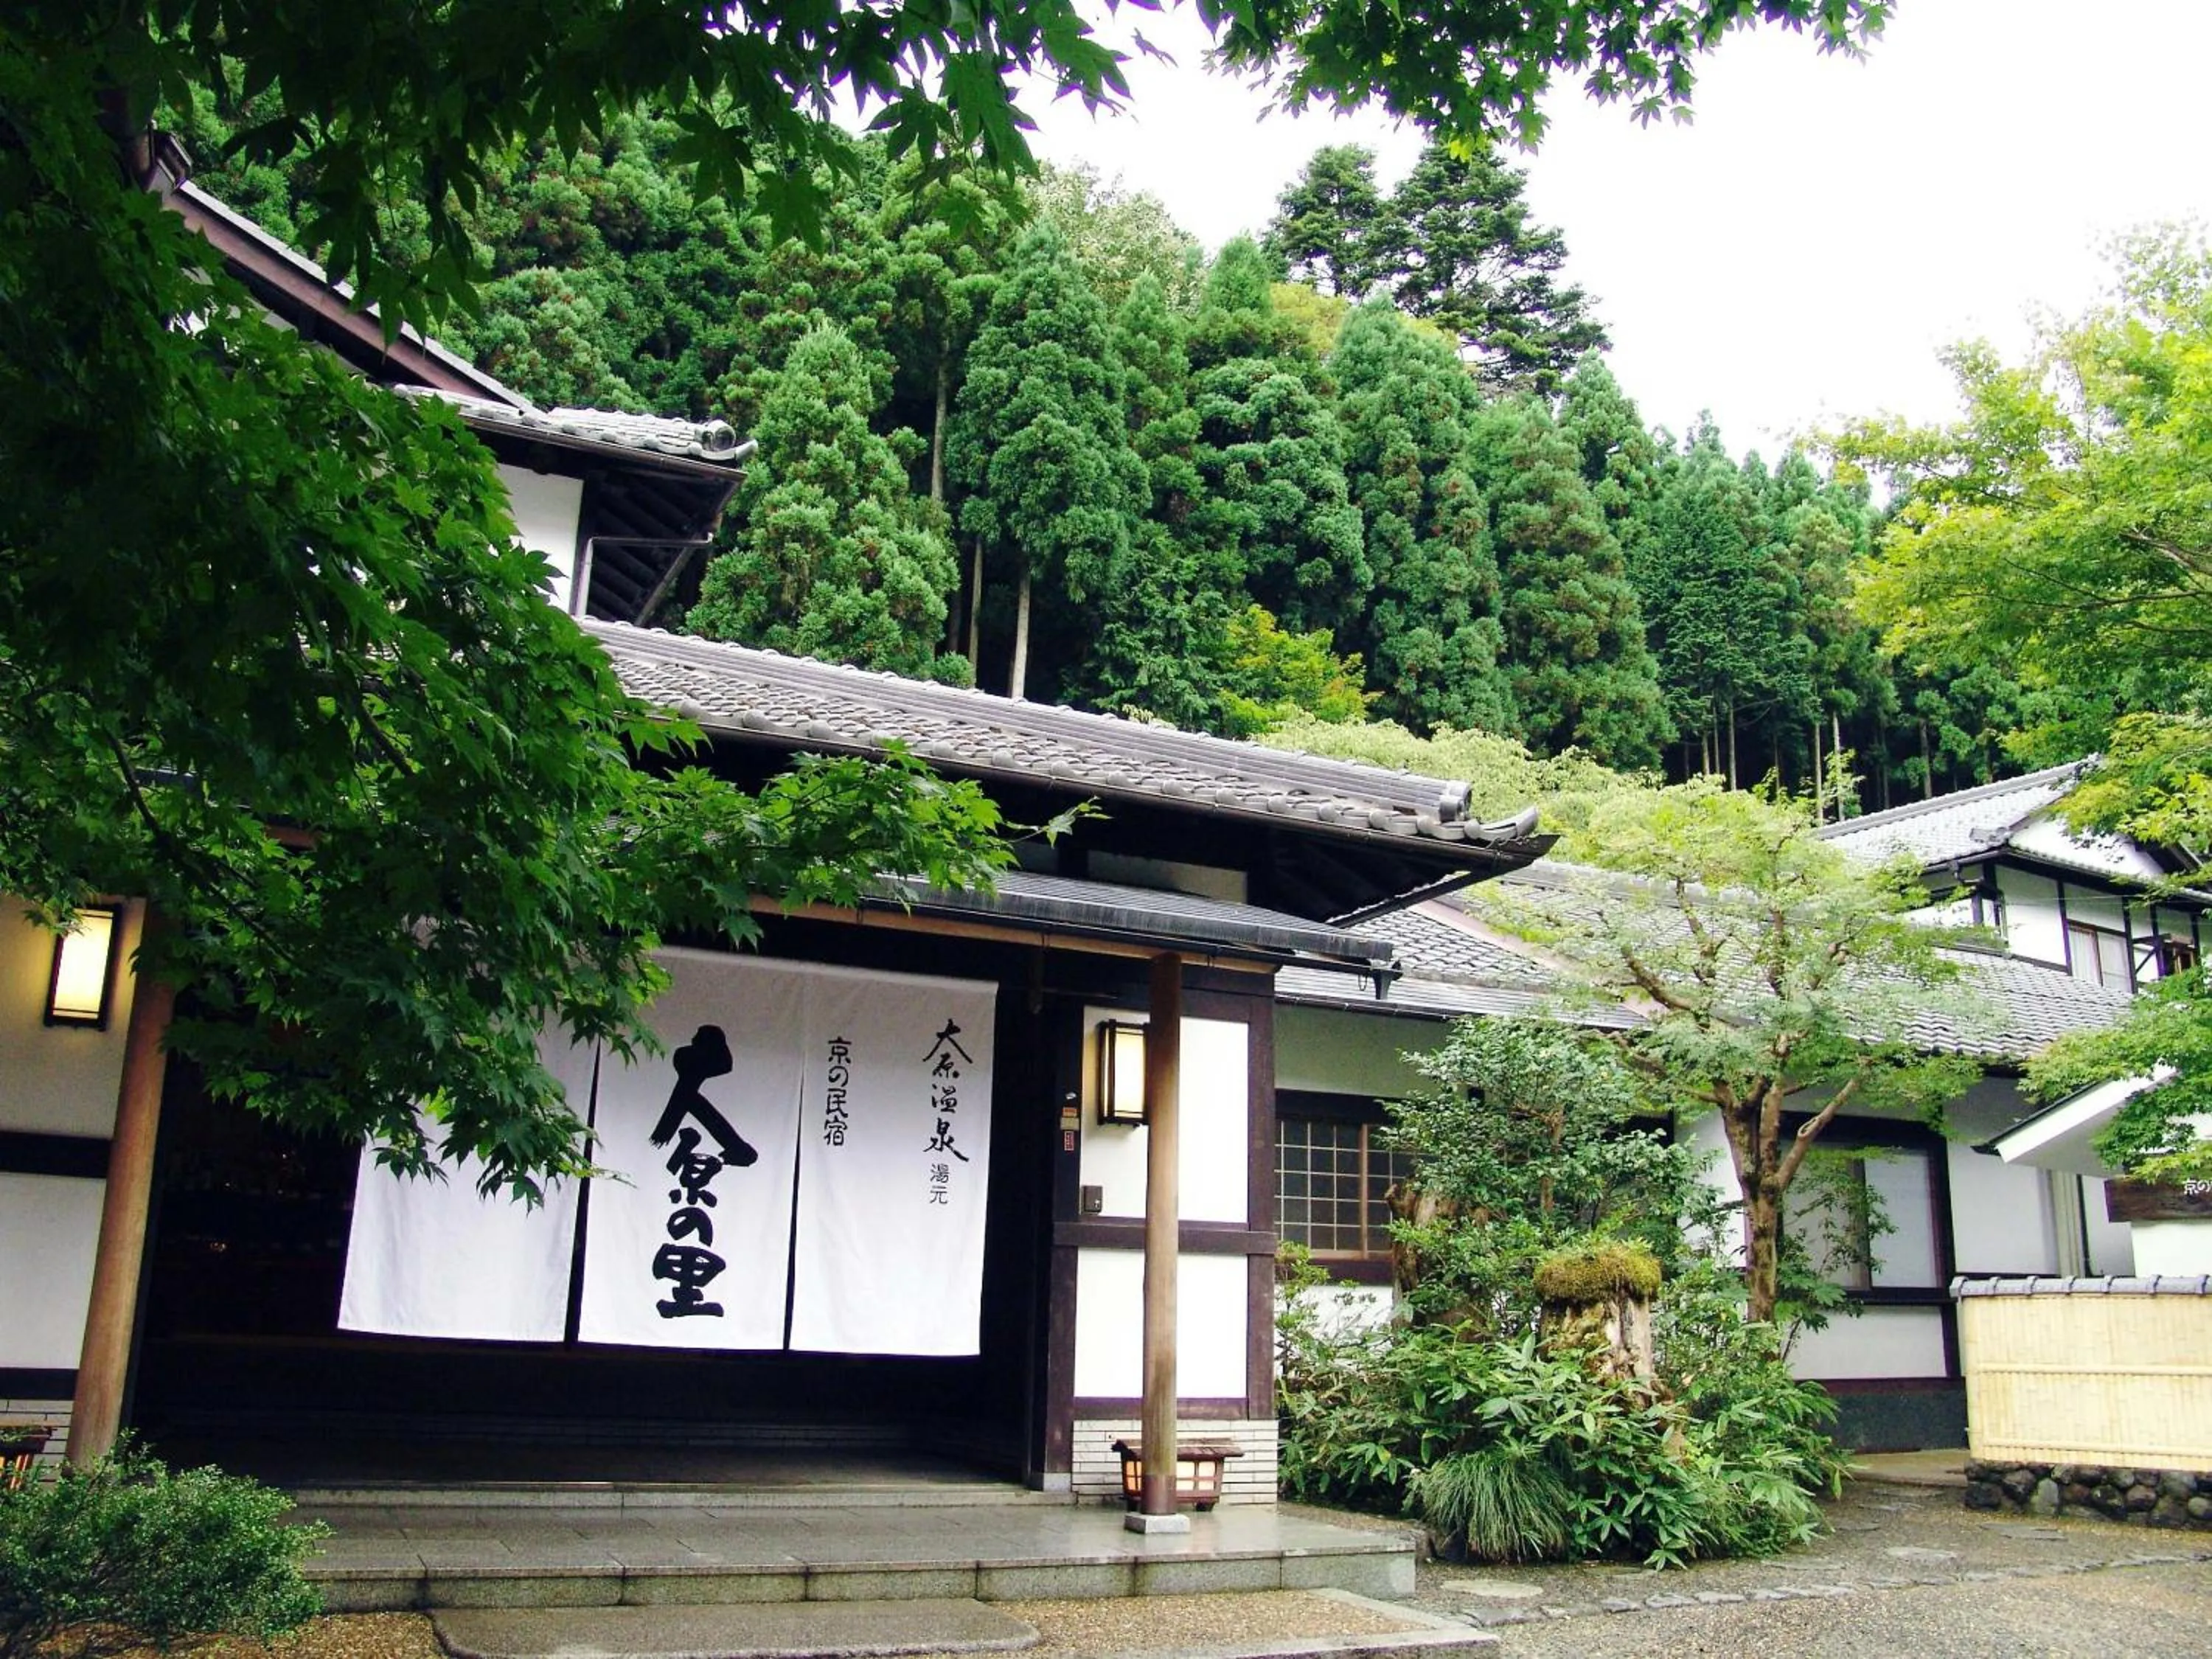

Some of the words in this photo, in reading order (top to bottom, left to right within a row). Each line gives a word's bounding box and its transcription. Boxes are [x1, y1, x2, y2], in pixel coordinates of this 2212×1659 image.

[649, 1023, 759, 1319] 大原の里
[823, 1036, 853, 1147] 京の民宿
